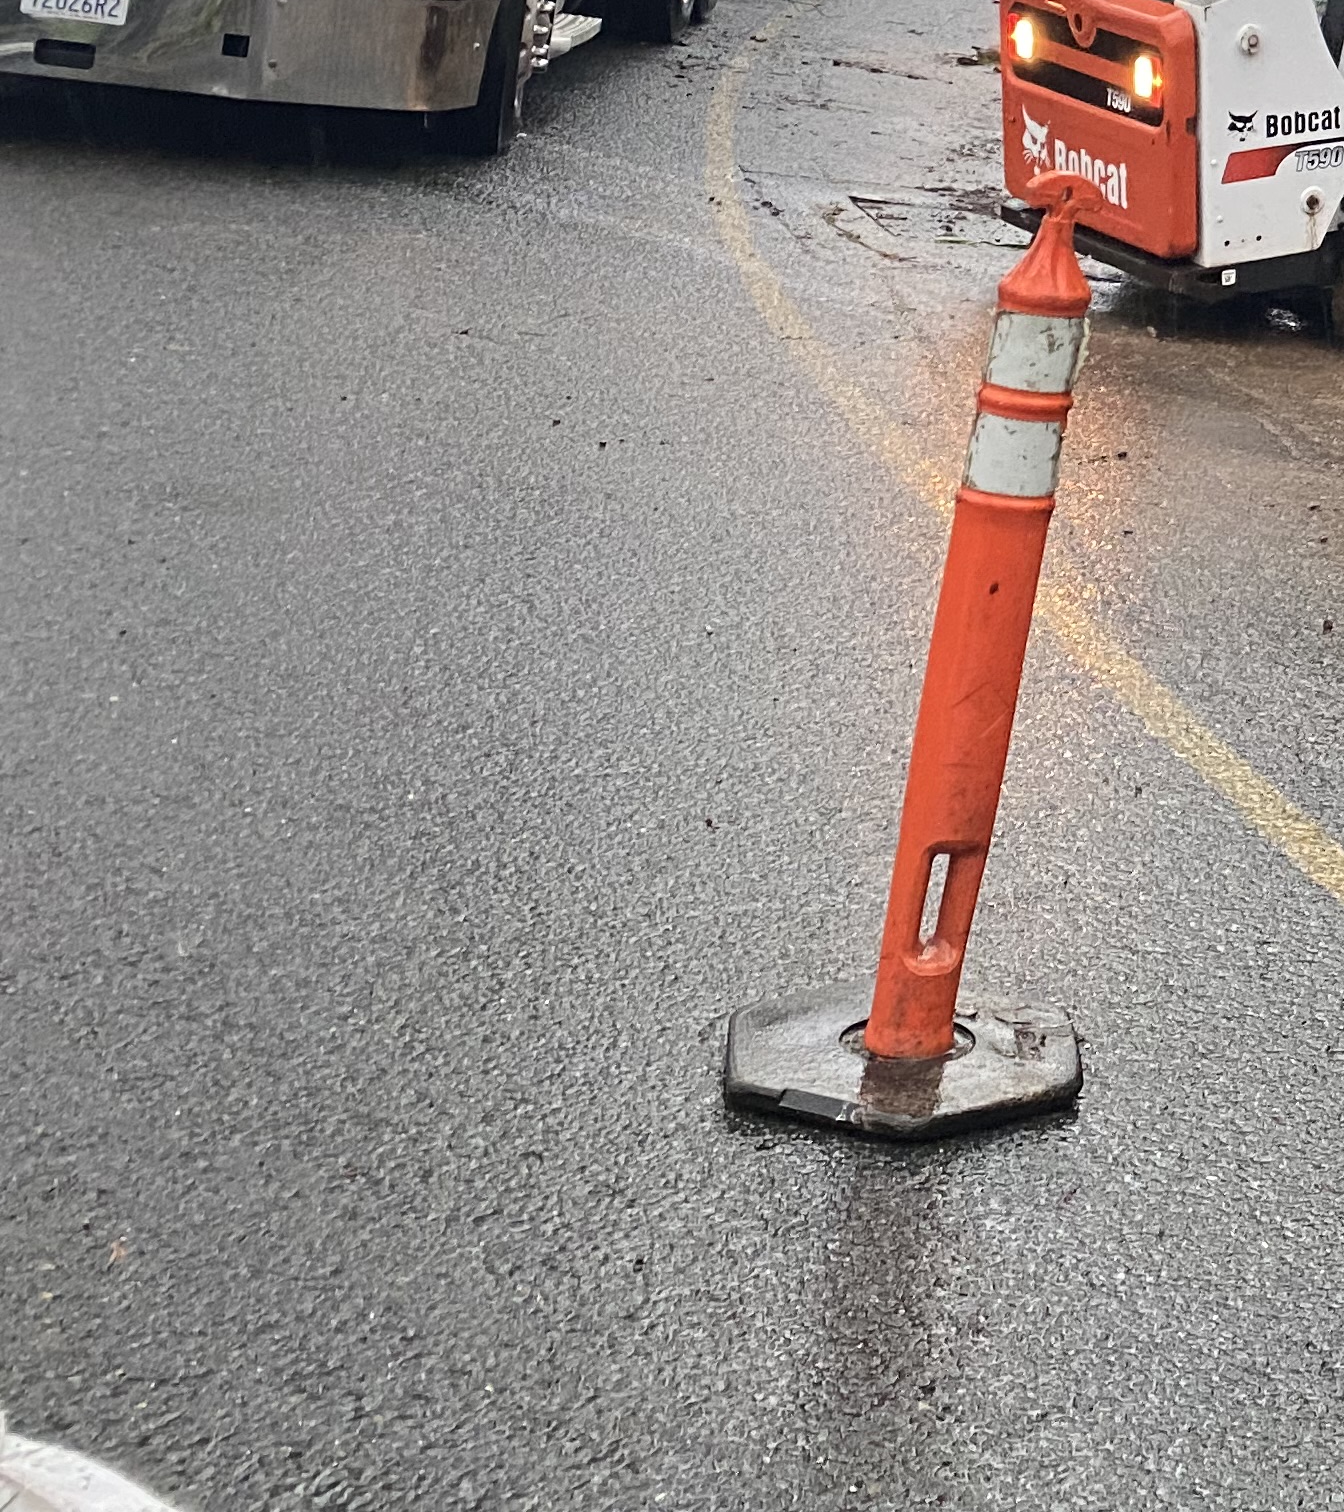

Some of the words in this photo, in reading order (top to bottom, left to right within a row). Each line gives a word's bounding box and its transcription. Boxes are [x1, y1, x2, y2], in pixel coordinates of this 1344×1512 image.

[1106, 87, 1132, 113] T590
[1266, 105, 1341, 139] Bobcat
[1294, 145, 1344, 173] T590
